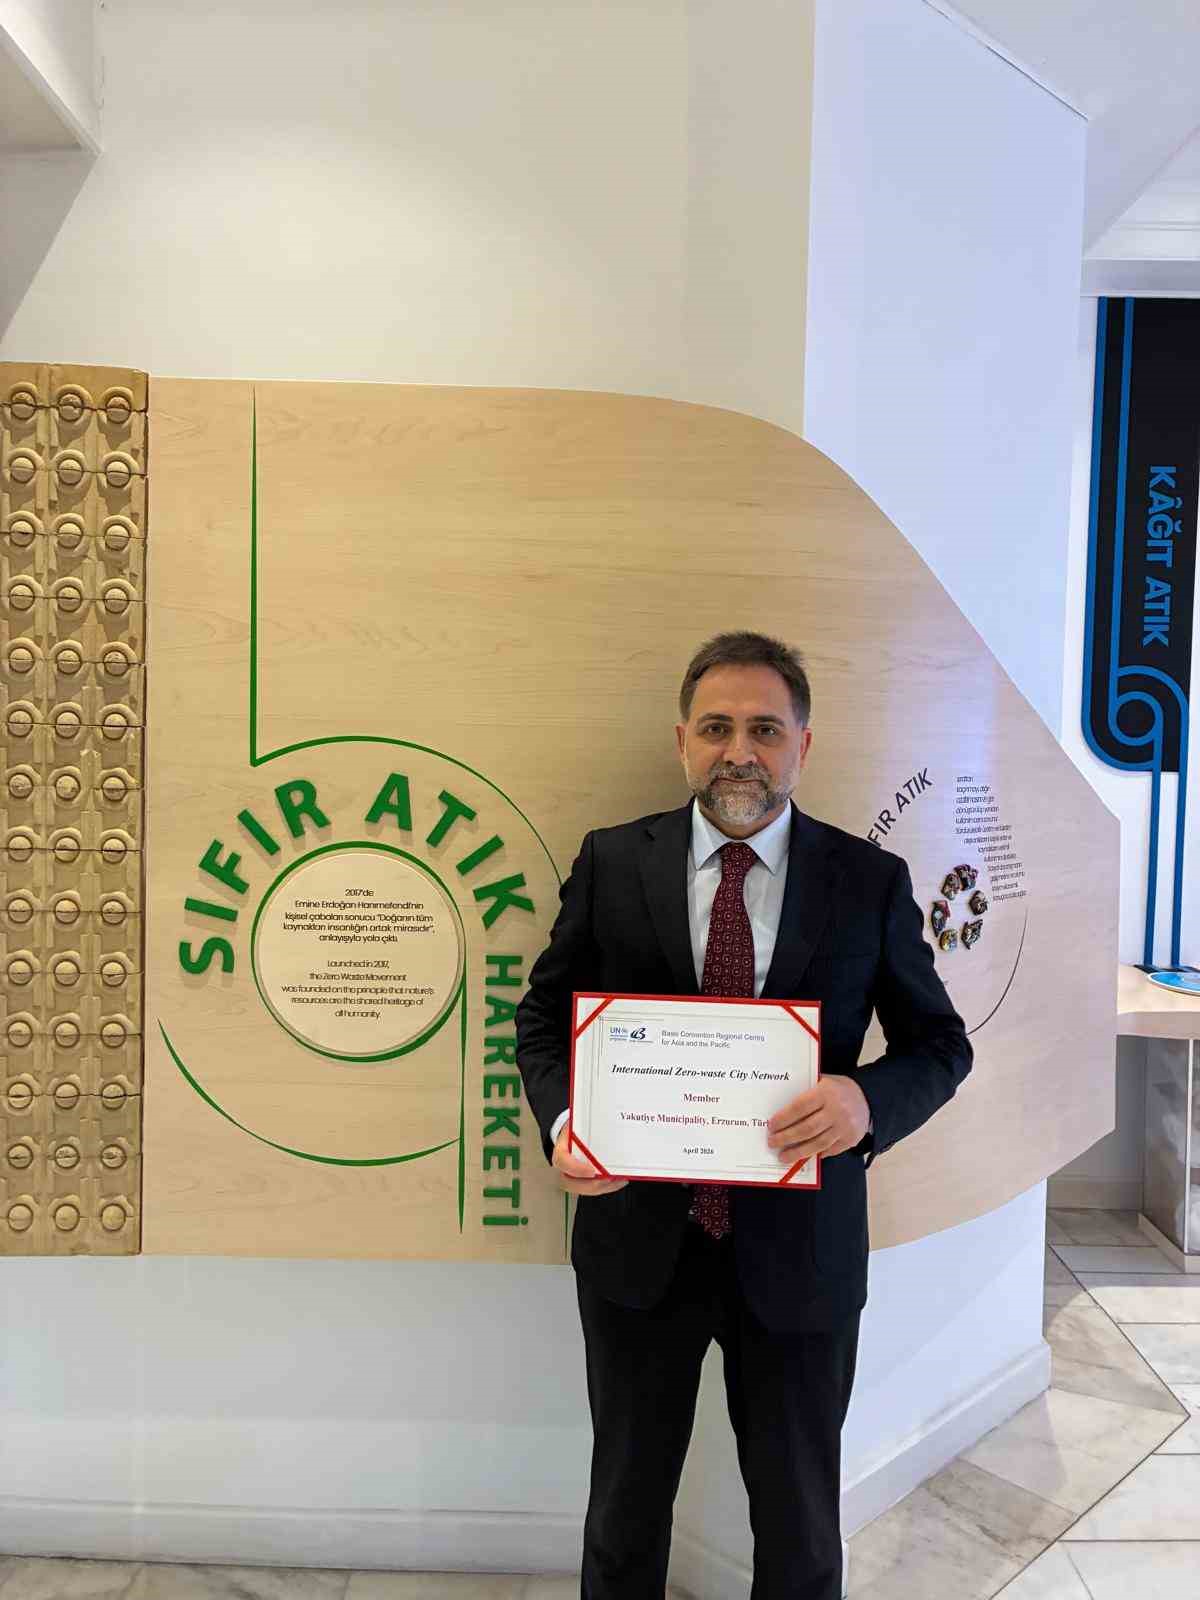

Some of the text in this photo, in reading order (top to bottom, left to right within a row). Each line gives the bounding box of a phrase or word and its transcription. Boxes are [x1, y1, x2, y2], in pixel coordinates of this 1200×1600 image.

[1143, 466, 1183, 647] KÂĞIT ATIK
[867, 768, 932, 847] FIR ATIK
[179, 772, 535, 975] SIFIR ATIK
[295, 900, 424, 910] Emine Erdoğan Hanımefendi'nin
[285, 912, 307, 922] kişisel
[416, 914, 434, 922] tüm
[369, 923, 391, 932] ortak
[363, 934, 380, 943] yola
[327, 960, 365, 968] Launched
[365, 960, 373, 968] in
[309, 972, 322, 980] the
[366, 973, 407, 981] Movement
[611, 1064, 790, 1081] International Zero-waste City Network
[683, 1093, 721, 1103] Member
[620, 1112, 655, 1124] Yakutiye
[656, 1113, 709, 1126] Municipality,
[682, 1146, 699, 1155] April
